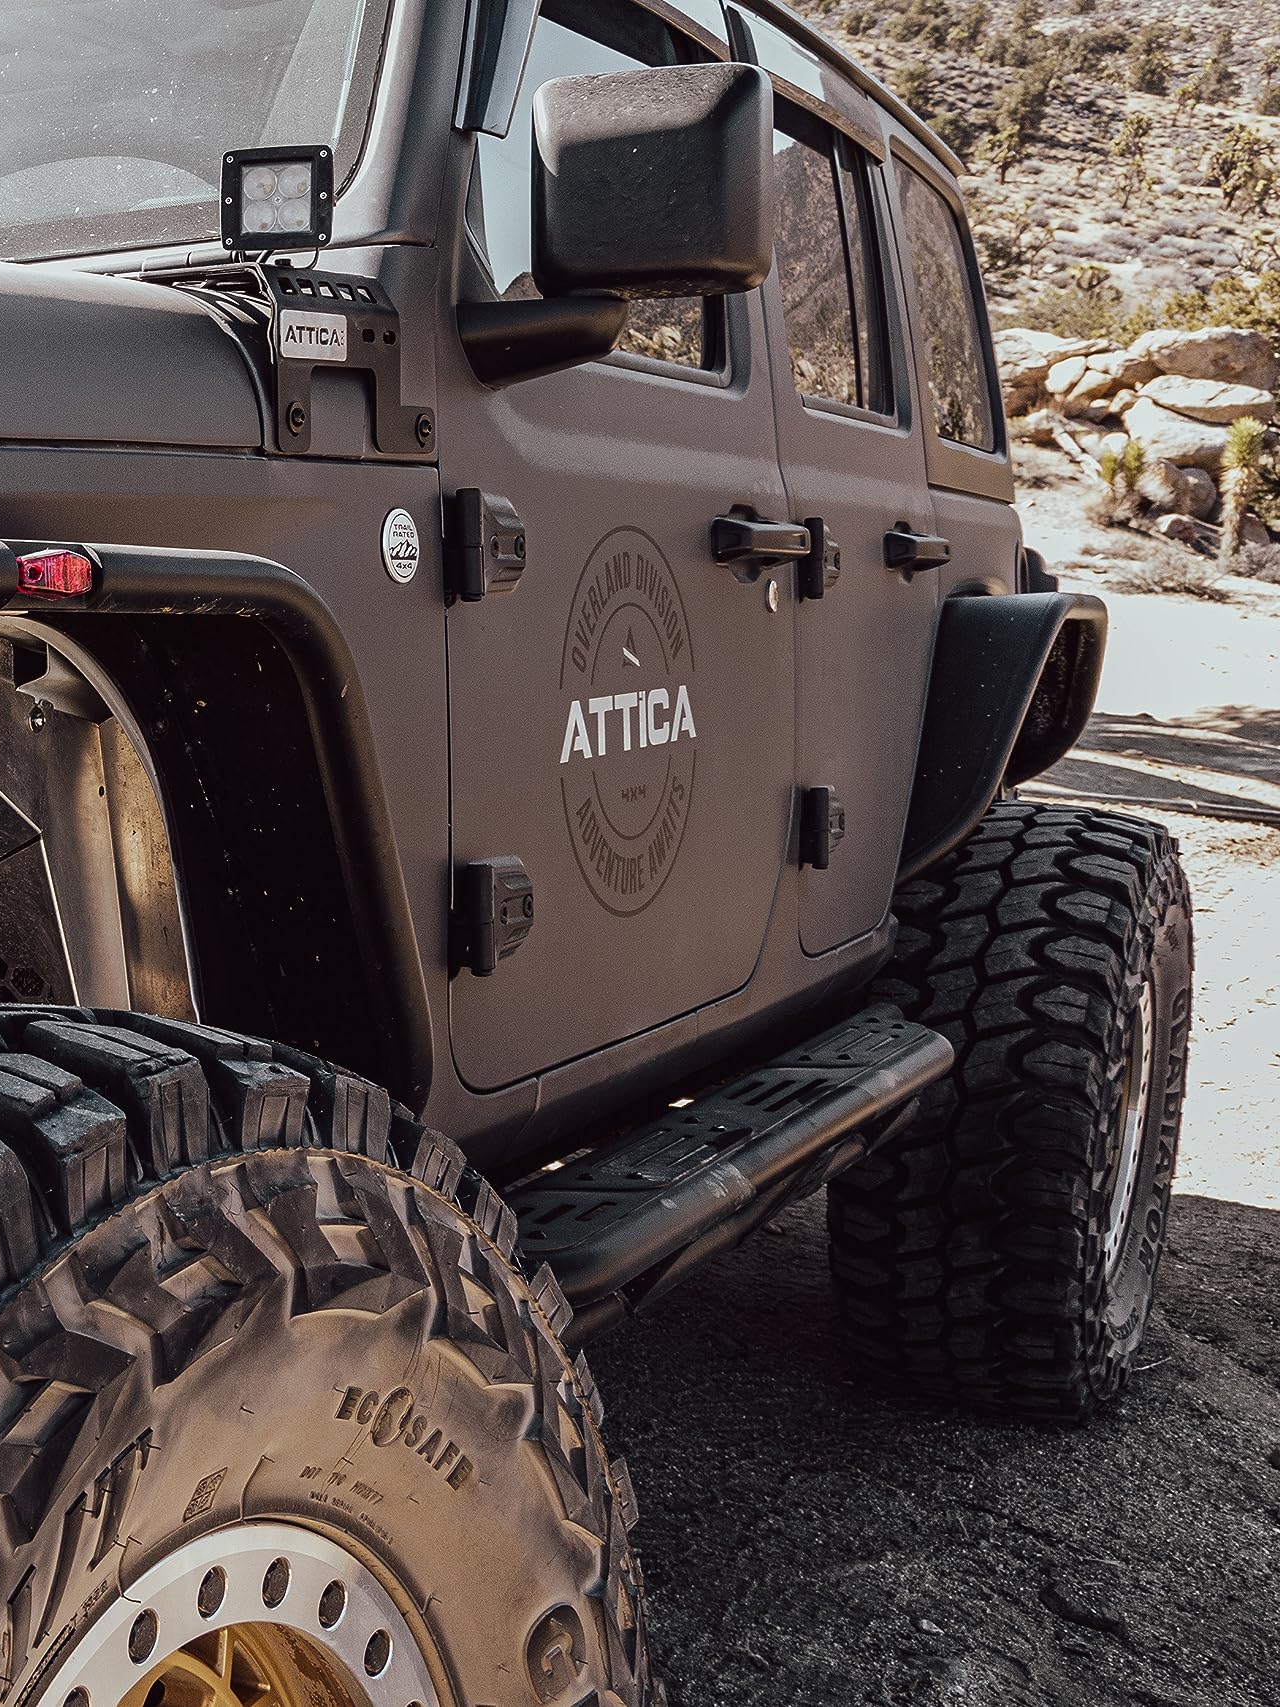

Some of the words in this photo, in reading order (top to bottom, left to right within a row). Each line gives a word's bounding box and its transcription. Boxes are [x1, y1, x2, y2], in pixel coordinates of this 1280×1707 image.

[571, 551, 631, 673] OVERLAND
[636, 553, 684, 661] DIVISION
[576, 797, 645, 895] ADVENTURE
[648, 775, 685, 881] AWAITS
